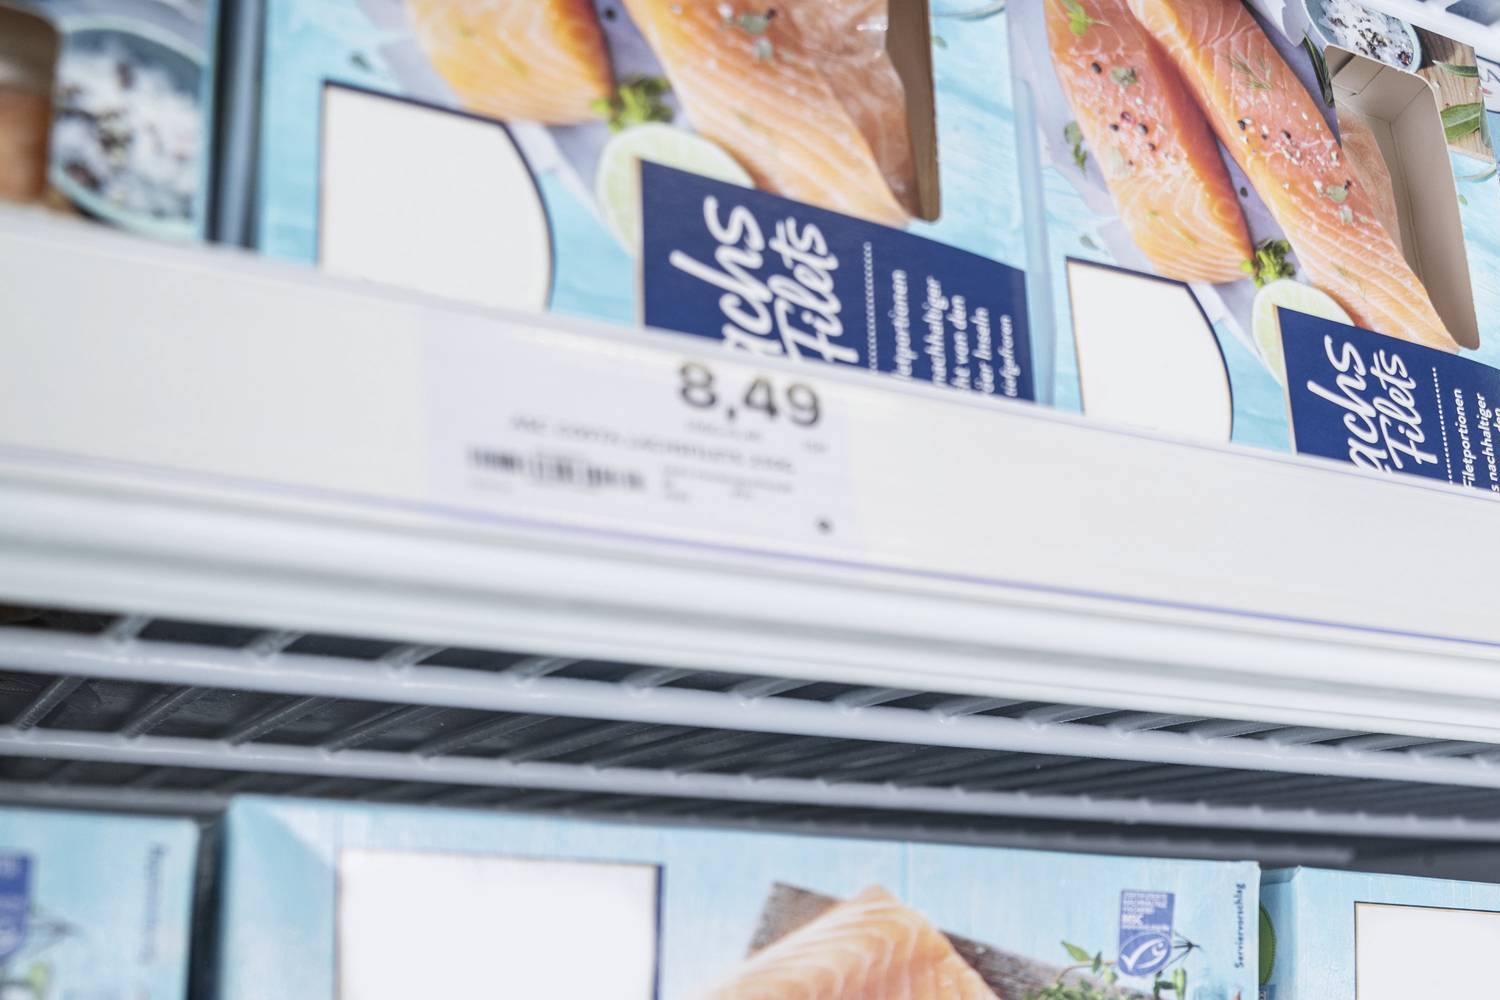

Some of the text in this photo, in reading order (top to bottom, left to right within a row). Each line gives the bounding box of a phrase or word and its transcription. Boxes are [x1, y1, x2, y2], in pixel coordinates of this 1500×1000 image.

[768, 216, 860, 363] Filets
[677, 360, 823, 428] 8,49
[1304, 334, 1394, 476] achs
[1371, 349, 1439, 470] Filets
[1474, 392, 1499, 482] nachhaltiger
